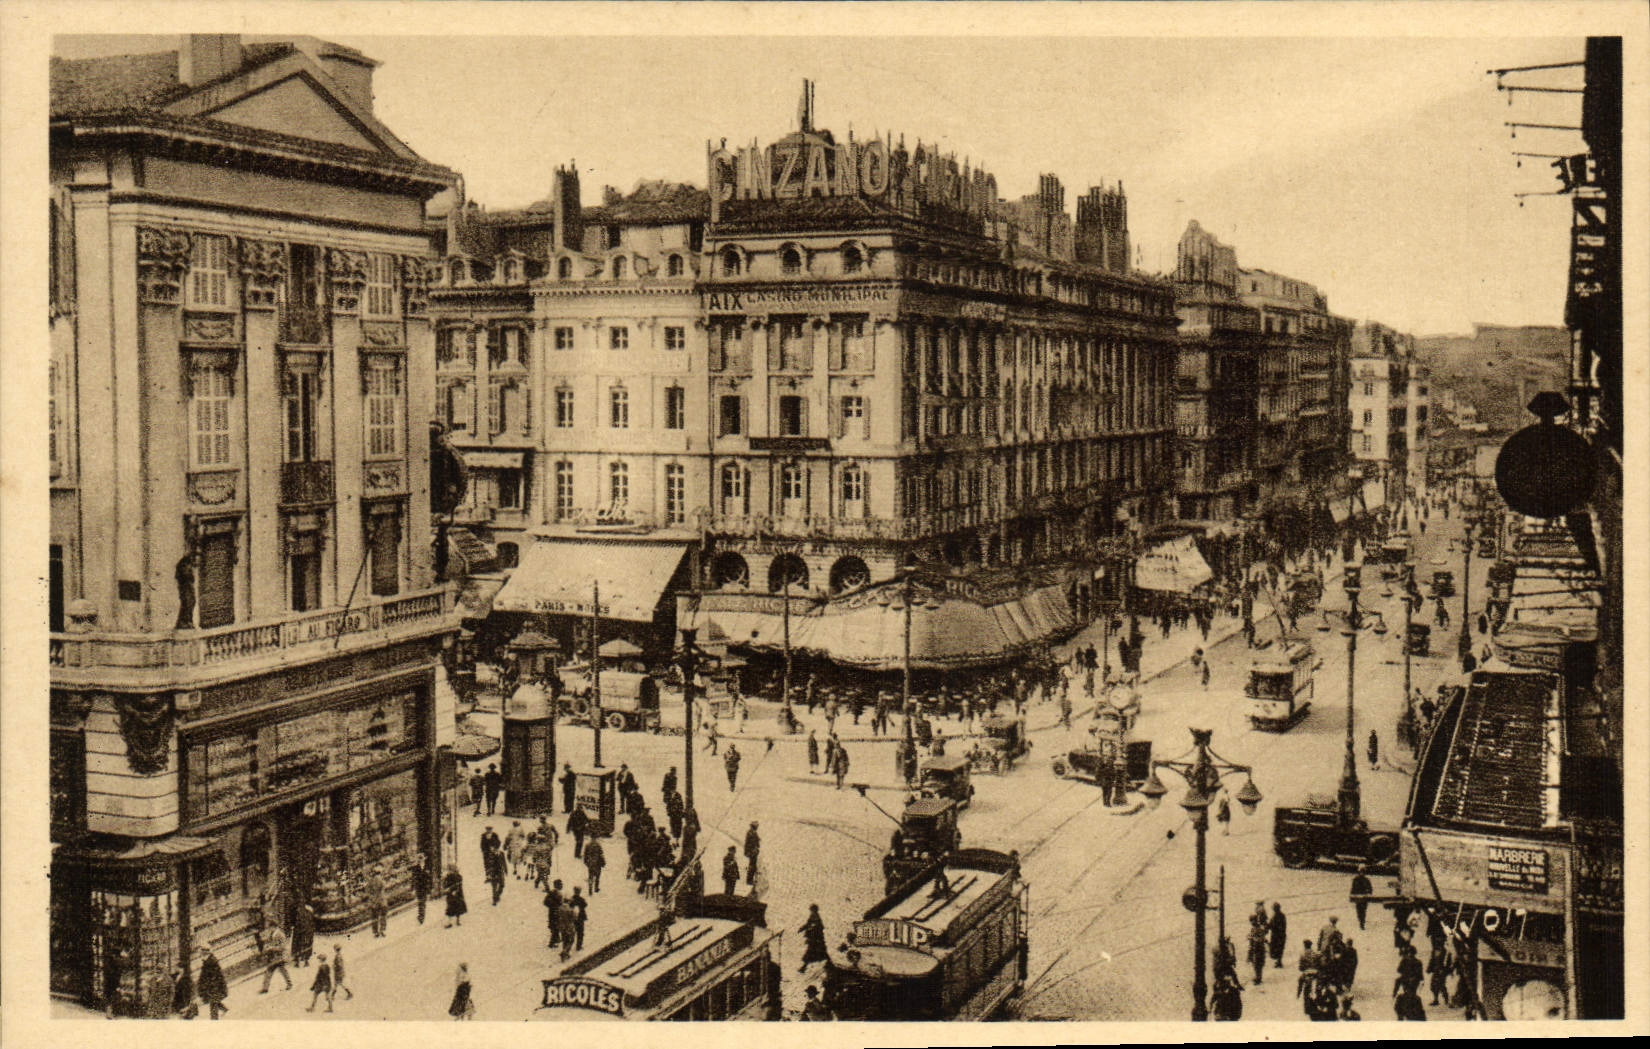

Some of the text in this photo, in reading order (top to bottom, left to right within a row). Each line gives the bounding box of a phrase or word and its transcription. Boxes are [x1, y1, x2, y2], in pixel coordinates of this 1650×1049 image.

[708, 140, 891, 203] CINZANO
[746, 291, 802, 303] CASINO
[807, 289, 890, 303] MUNICIPAL
[534, 600, 566, 612] PARIS
[307, 623, 321, 640] AU
[889, 921, 928, 948] LIP
